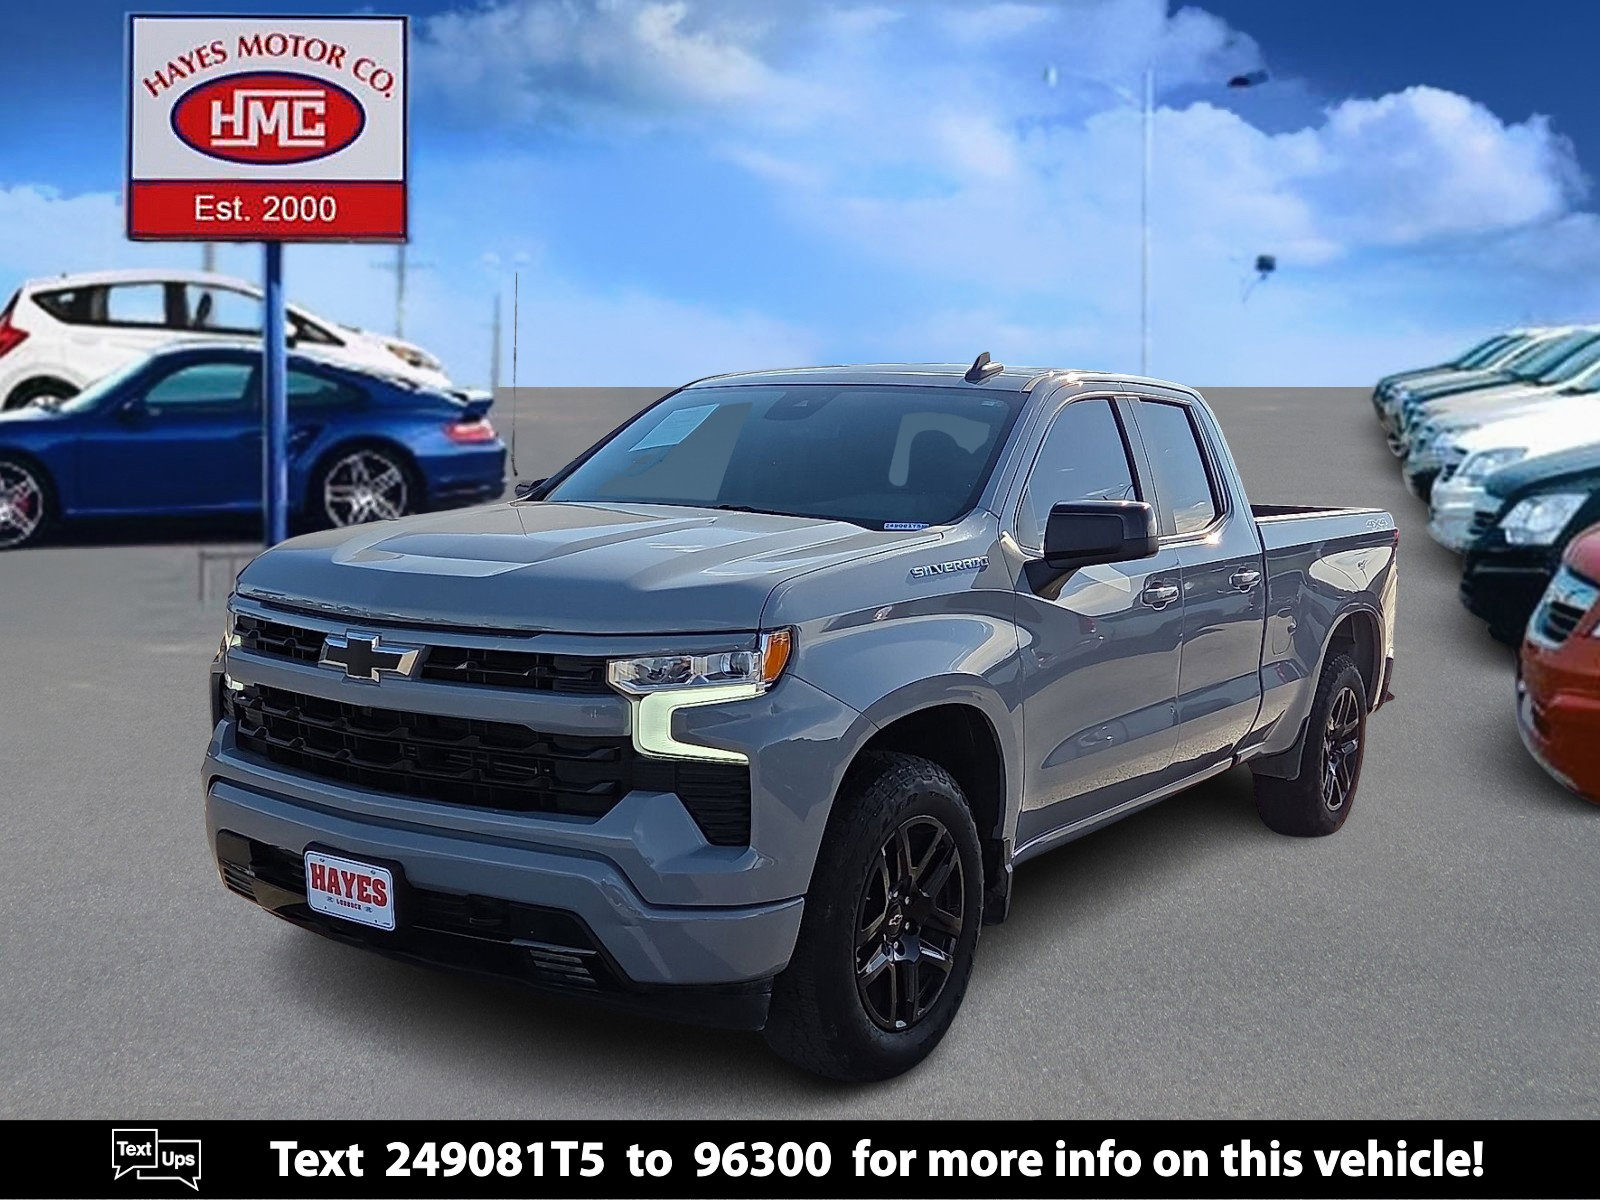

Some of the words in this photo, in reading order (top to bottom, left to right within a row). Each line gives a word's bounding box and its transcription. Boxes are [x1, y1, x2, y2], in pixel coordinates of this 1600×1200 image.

[142, 40, 228, 97] HAYES
[237, 33, 347, 69] MOTOR
[352, 57, 395, 98] CO.
[210, 89, 326, 147] HMC
[194, 194, 251, 222] Est.
[262, 195, 337, 222] 2000
[910, 555, 990, 578] SILVERADO
[309, 862, 388, 907] HAYES
